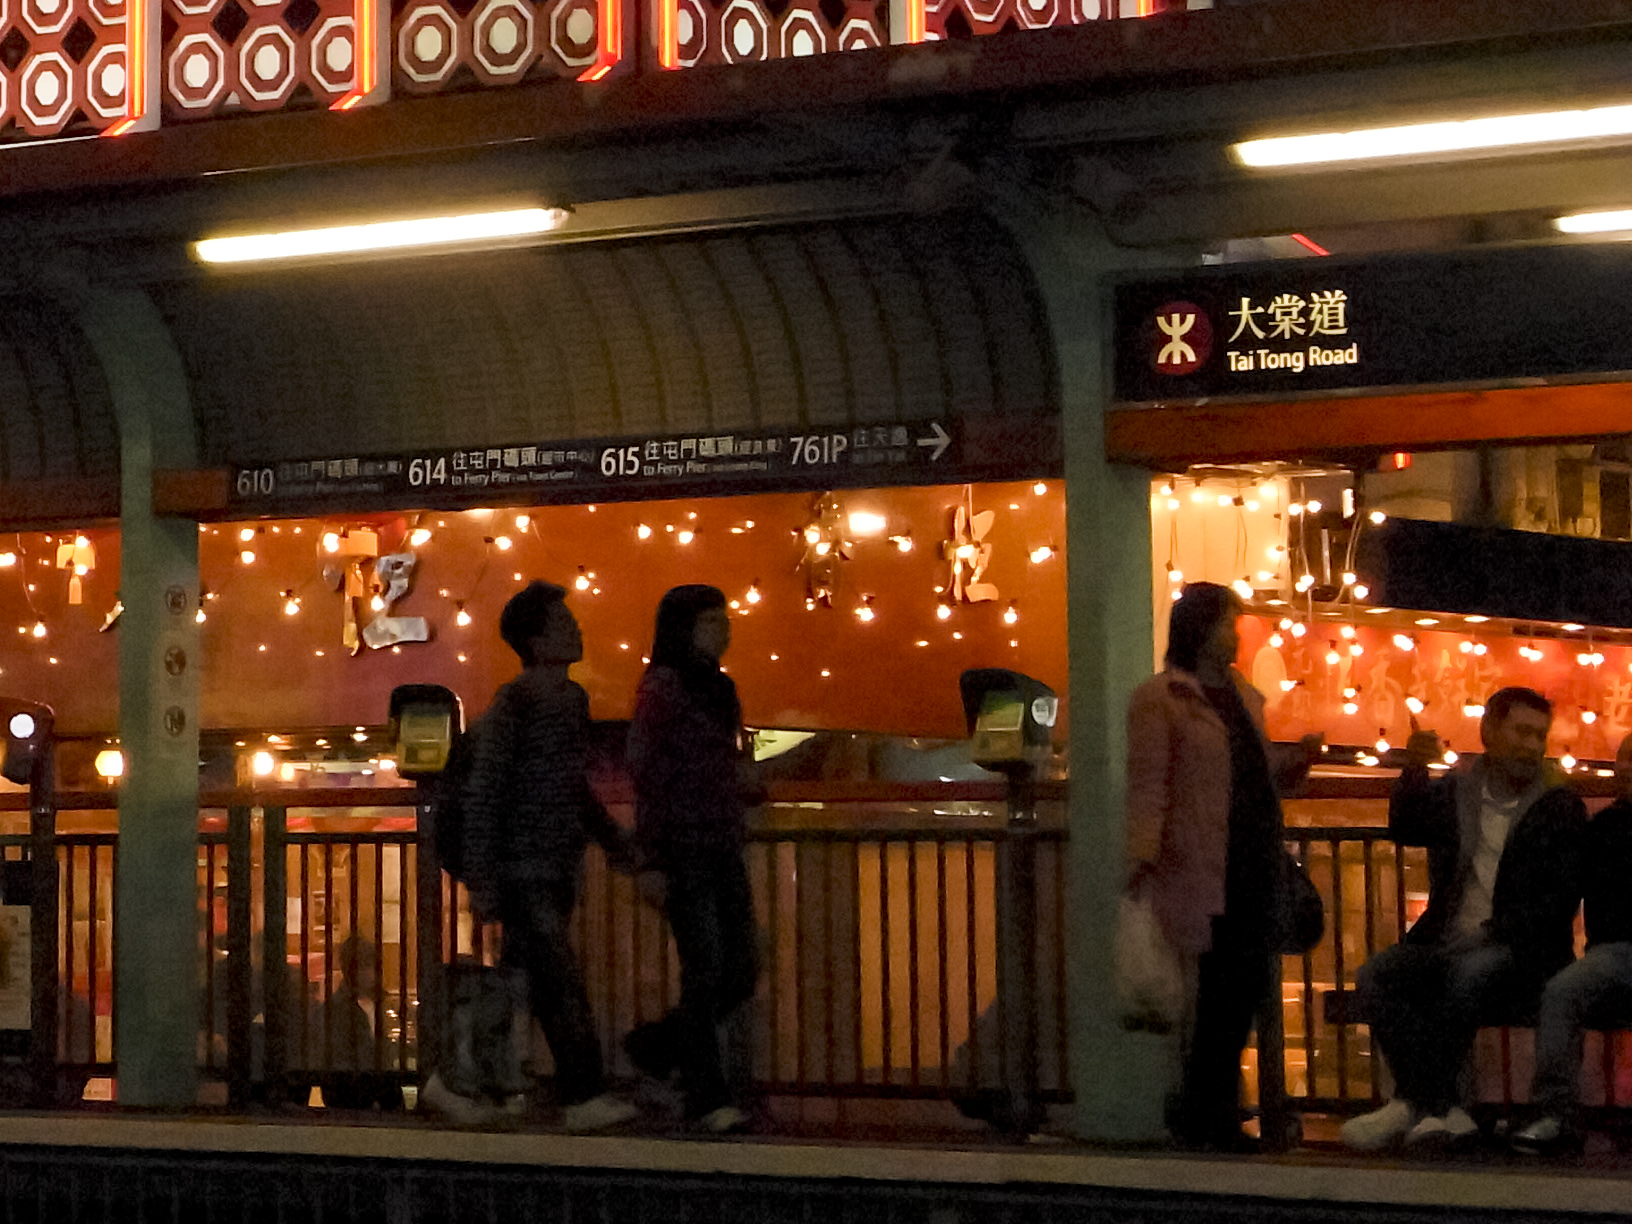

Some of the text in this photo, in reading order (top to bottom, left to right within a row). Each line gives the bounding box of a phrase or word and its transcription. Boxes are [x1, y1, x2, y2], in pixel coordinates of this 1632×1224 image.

[1227, 289, 1349, 344] 大棠道
[1227, 342, 1358, 373] Tai Tong Road
[600, 446, 640, 476] 615
[789, 433, 849, 465] 761P
[237, 467, 274, 496] 610
[408, 457, 446, 486] 614
